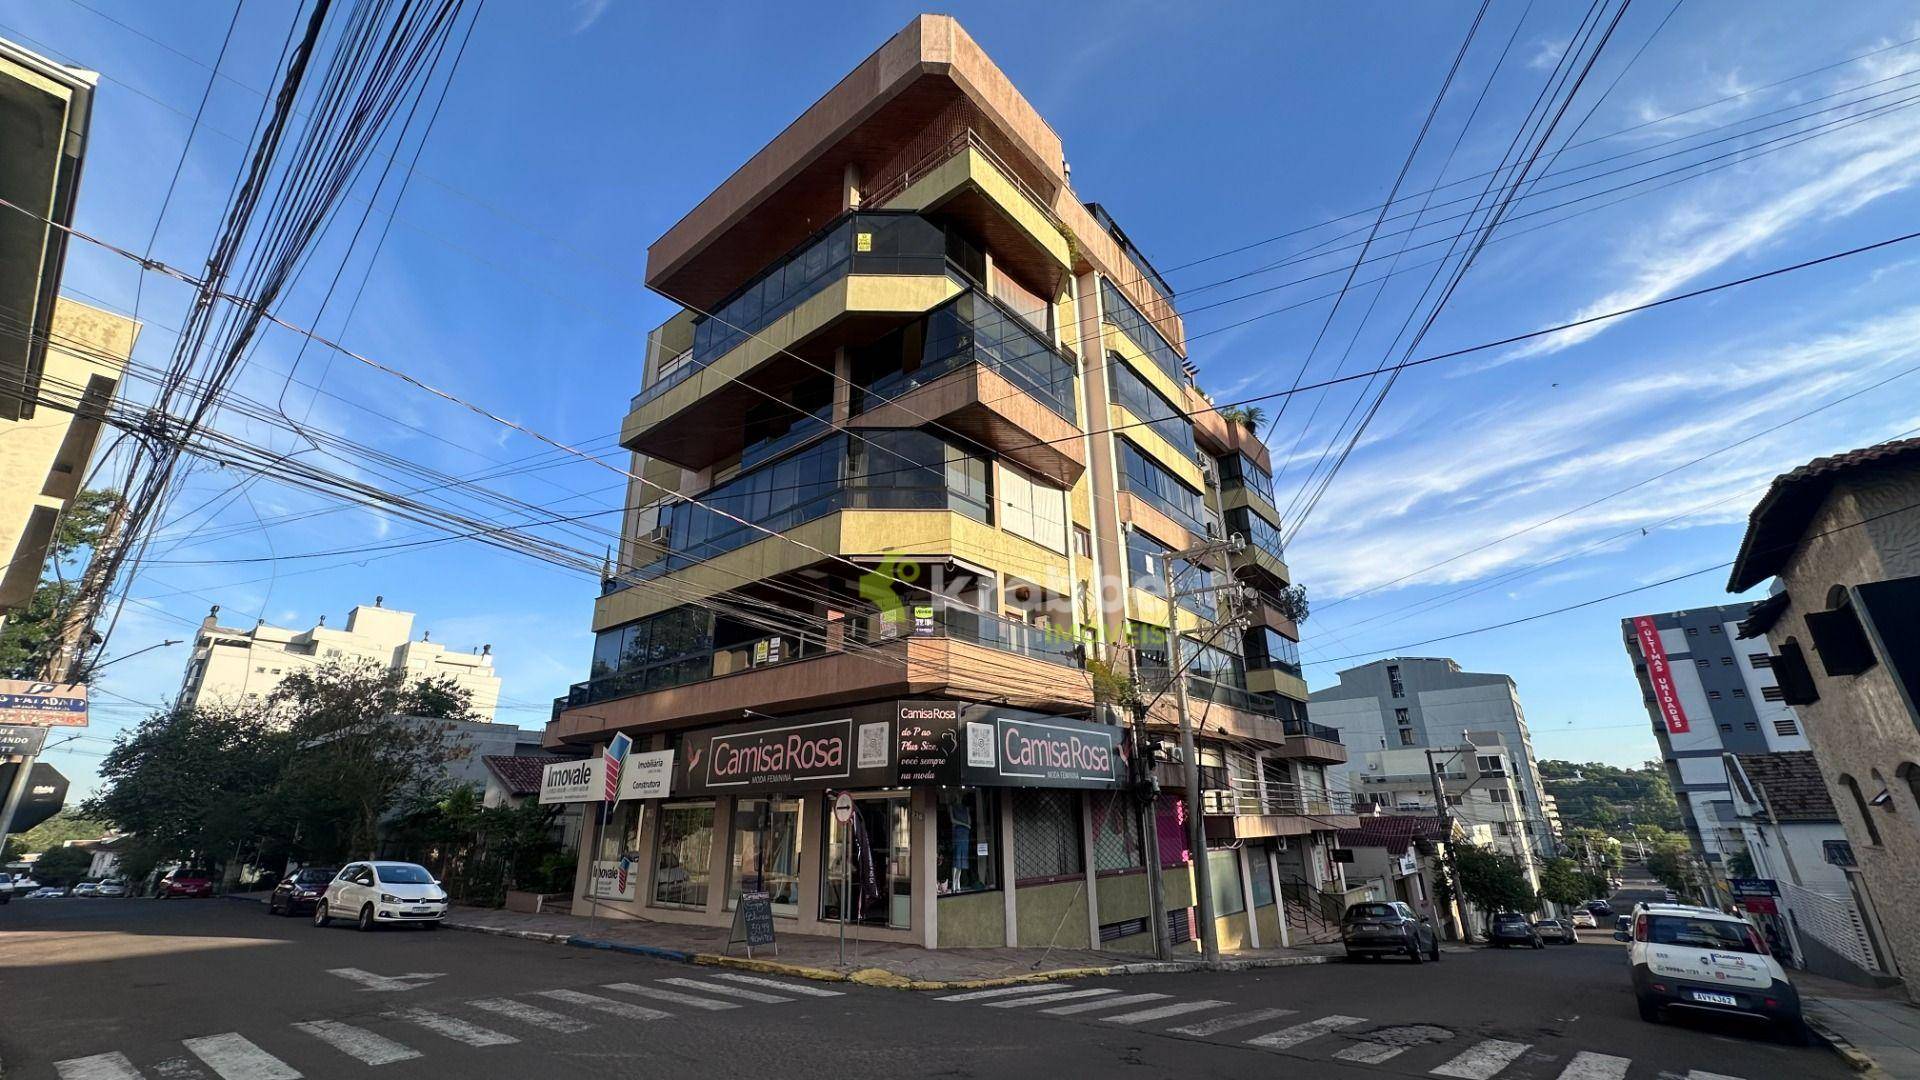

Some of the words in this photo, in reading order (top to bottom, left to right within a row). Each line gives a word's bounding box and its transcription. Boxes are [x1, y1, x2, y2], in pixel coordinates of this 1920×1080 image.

[1643, 628, 1664, 673] ÚLTIMAS
[1658, 677, 1683, 728] UNIDADES
[901, 740, 919, 751] Plus
[637, 758, 664, 770] Imobiliária
[901, 756, 919, 765] você
[920, 758, 946, 768] sempre
[547, 763, 592, 788] Imovale
[751, 775, 766, 784] MODA
[767, 773, 791, 783] FEMININA
[901, 772, 912, 780] na
[913, 770, 936, 780] moda
[632, 780, 661, 790] Construtora
